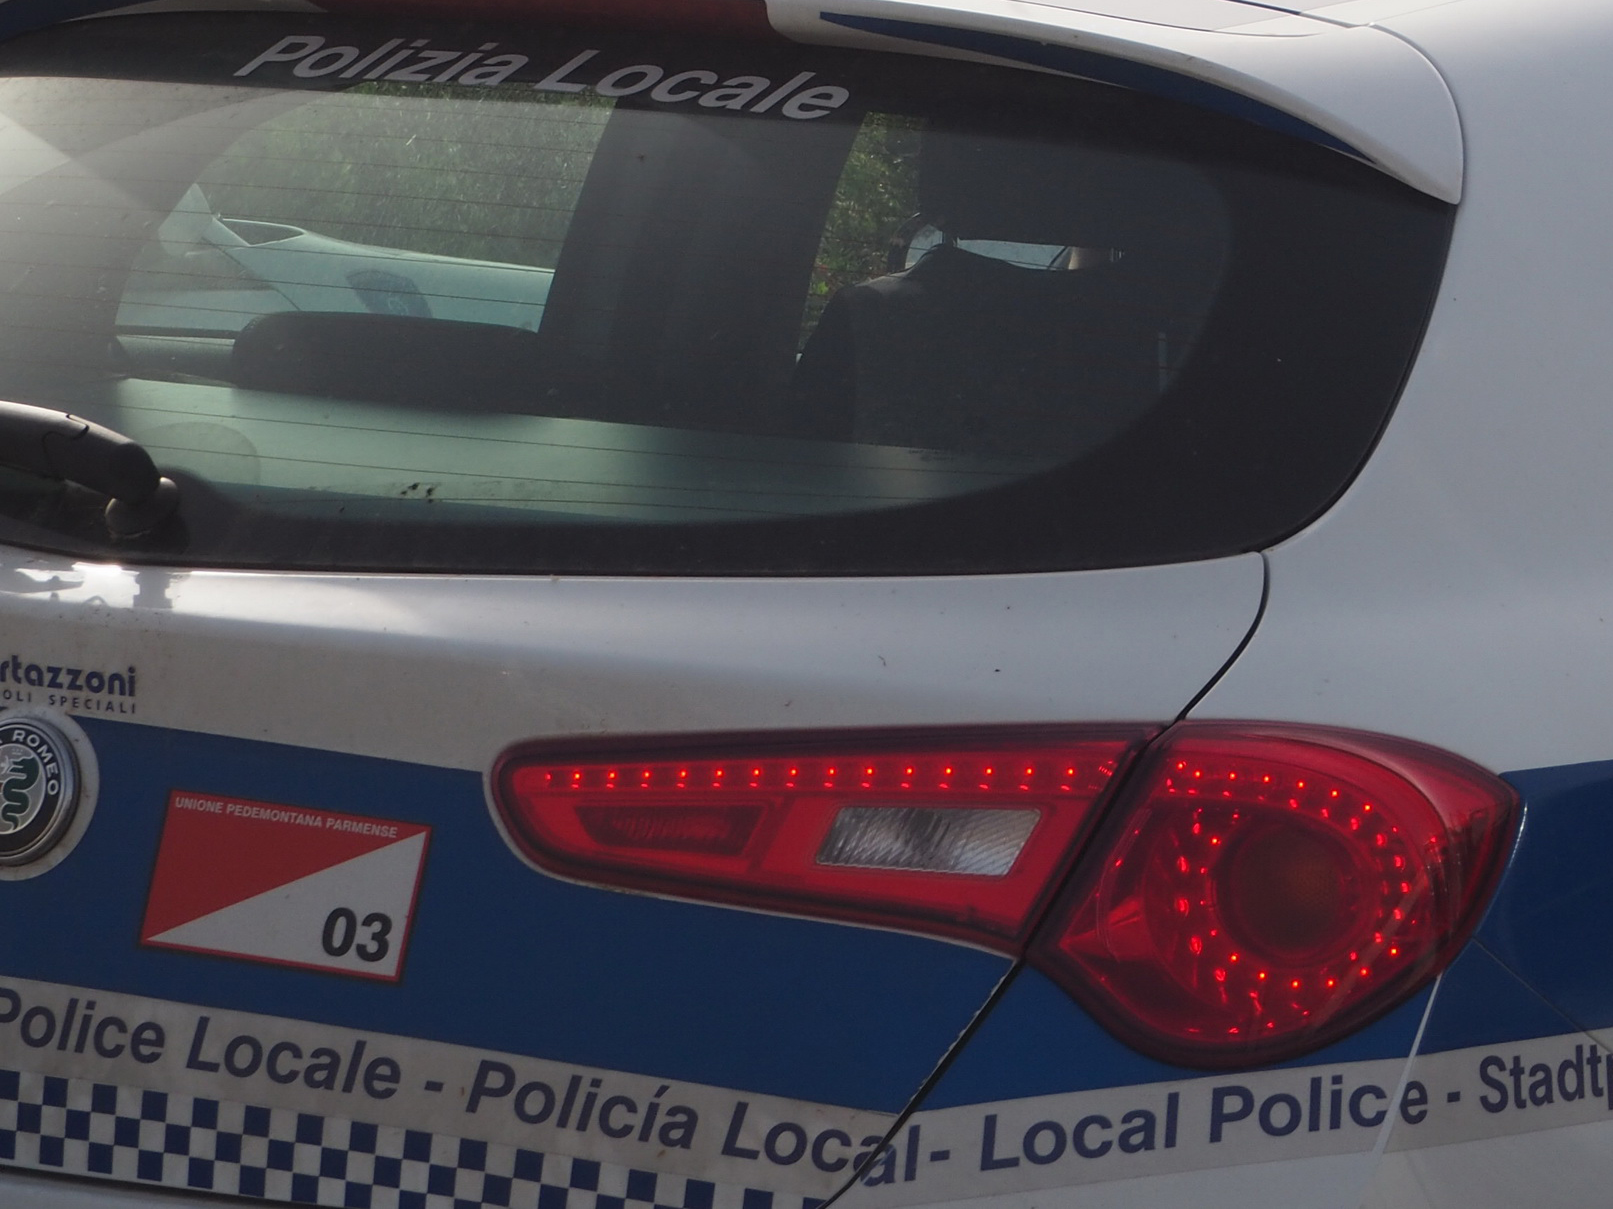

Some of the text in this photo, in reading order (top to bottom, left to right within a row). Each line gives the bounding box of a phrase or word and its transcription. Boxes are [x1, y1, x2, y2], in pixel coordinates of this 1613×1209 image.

[233, 35, 850, 120] Polizia Locale
[49, 694, 137, 714] SPECIALI
[12, 729, 60, 796] ROMEO
[175, 796, 398, 839] UNIONE PEDEMONTANA PARMENSE
[321, 907, 393, 962] 03
[185, 1016, 401, 1100] Locale
[465, 1059, 699, 1150] Policía
[979, 1091, 1180, 1172] Local
[1208, 1074, 1429, 1143] Police
